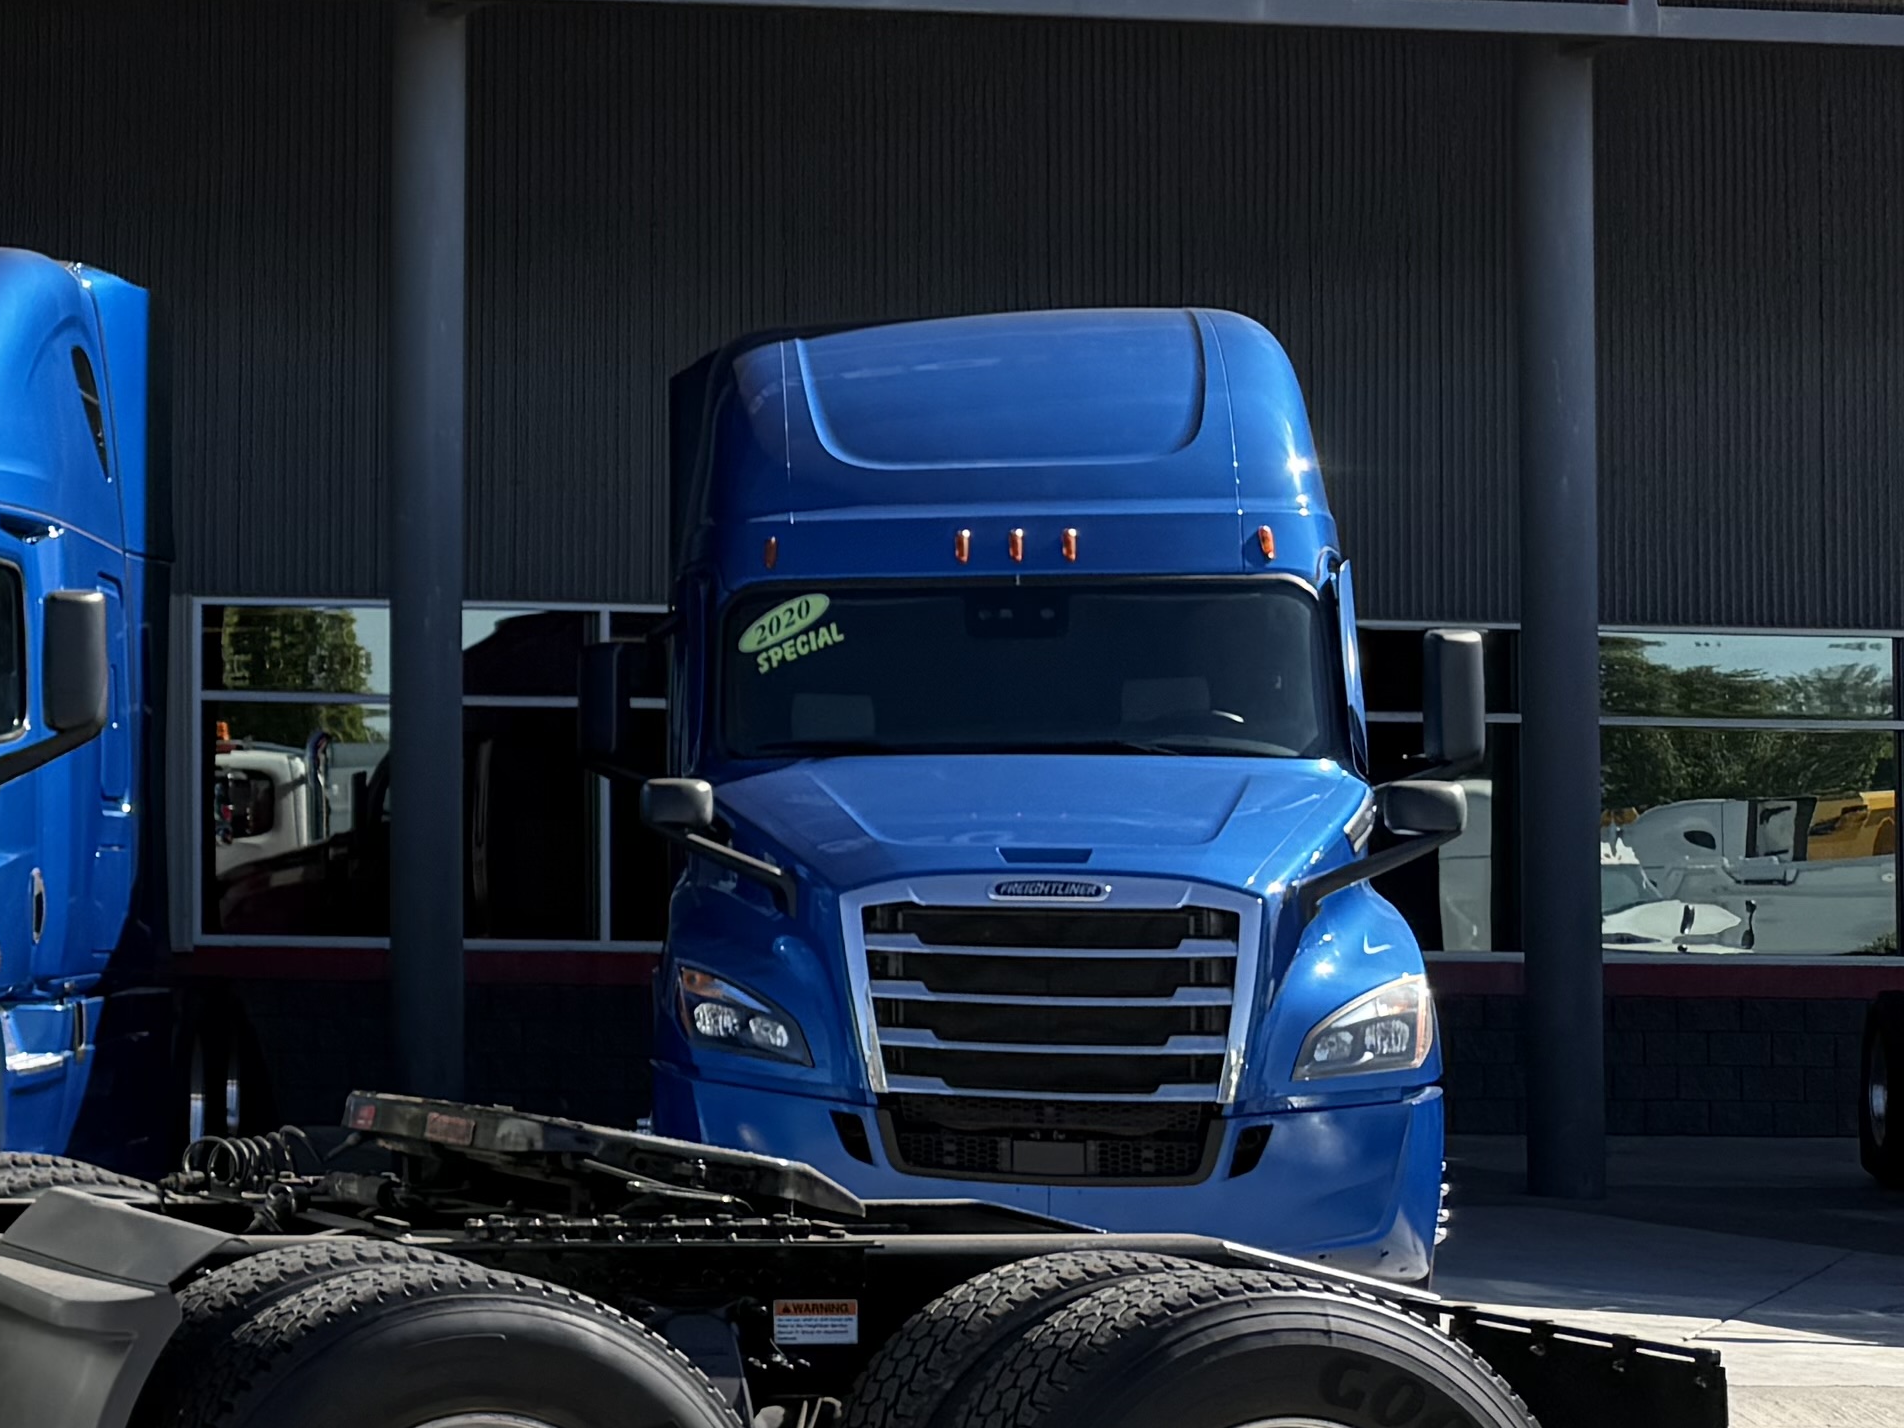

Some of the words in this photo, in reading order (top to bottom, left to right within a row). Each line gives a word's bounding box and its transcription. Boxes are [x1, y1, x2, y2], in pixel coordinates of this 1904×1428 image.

[754, 599, 811, 646] 2020
[756, 622, 845, 675] SPECIAL
[999, 882, 1097, 896] FREIGHTLINER
[792, 1303, 849, 1314] WARNING
